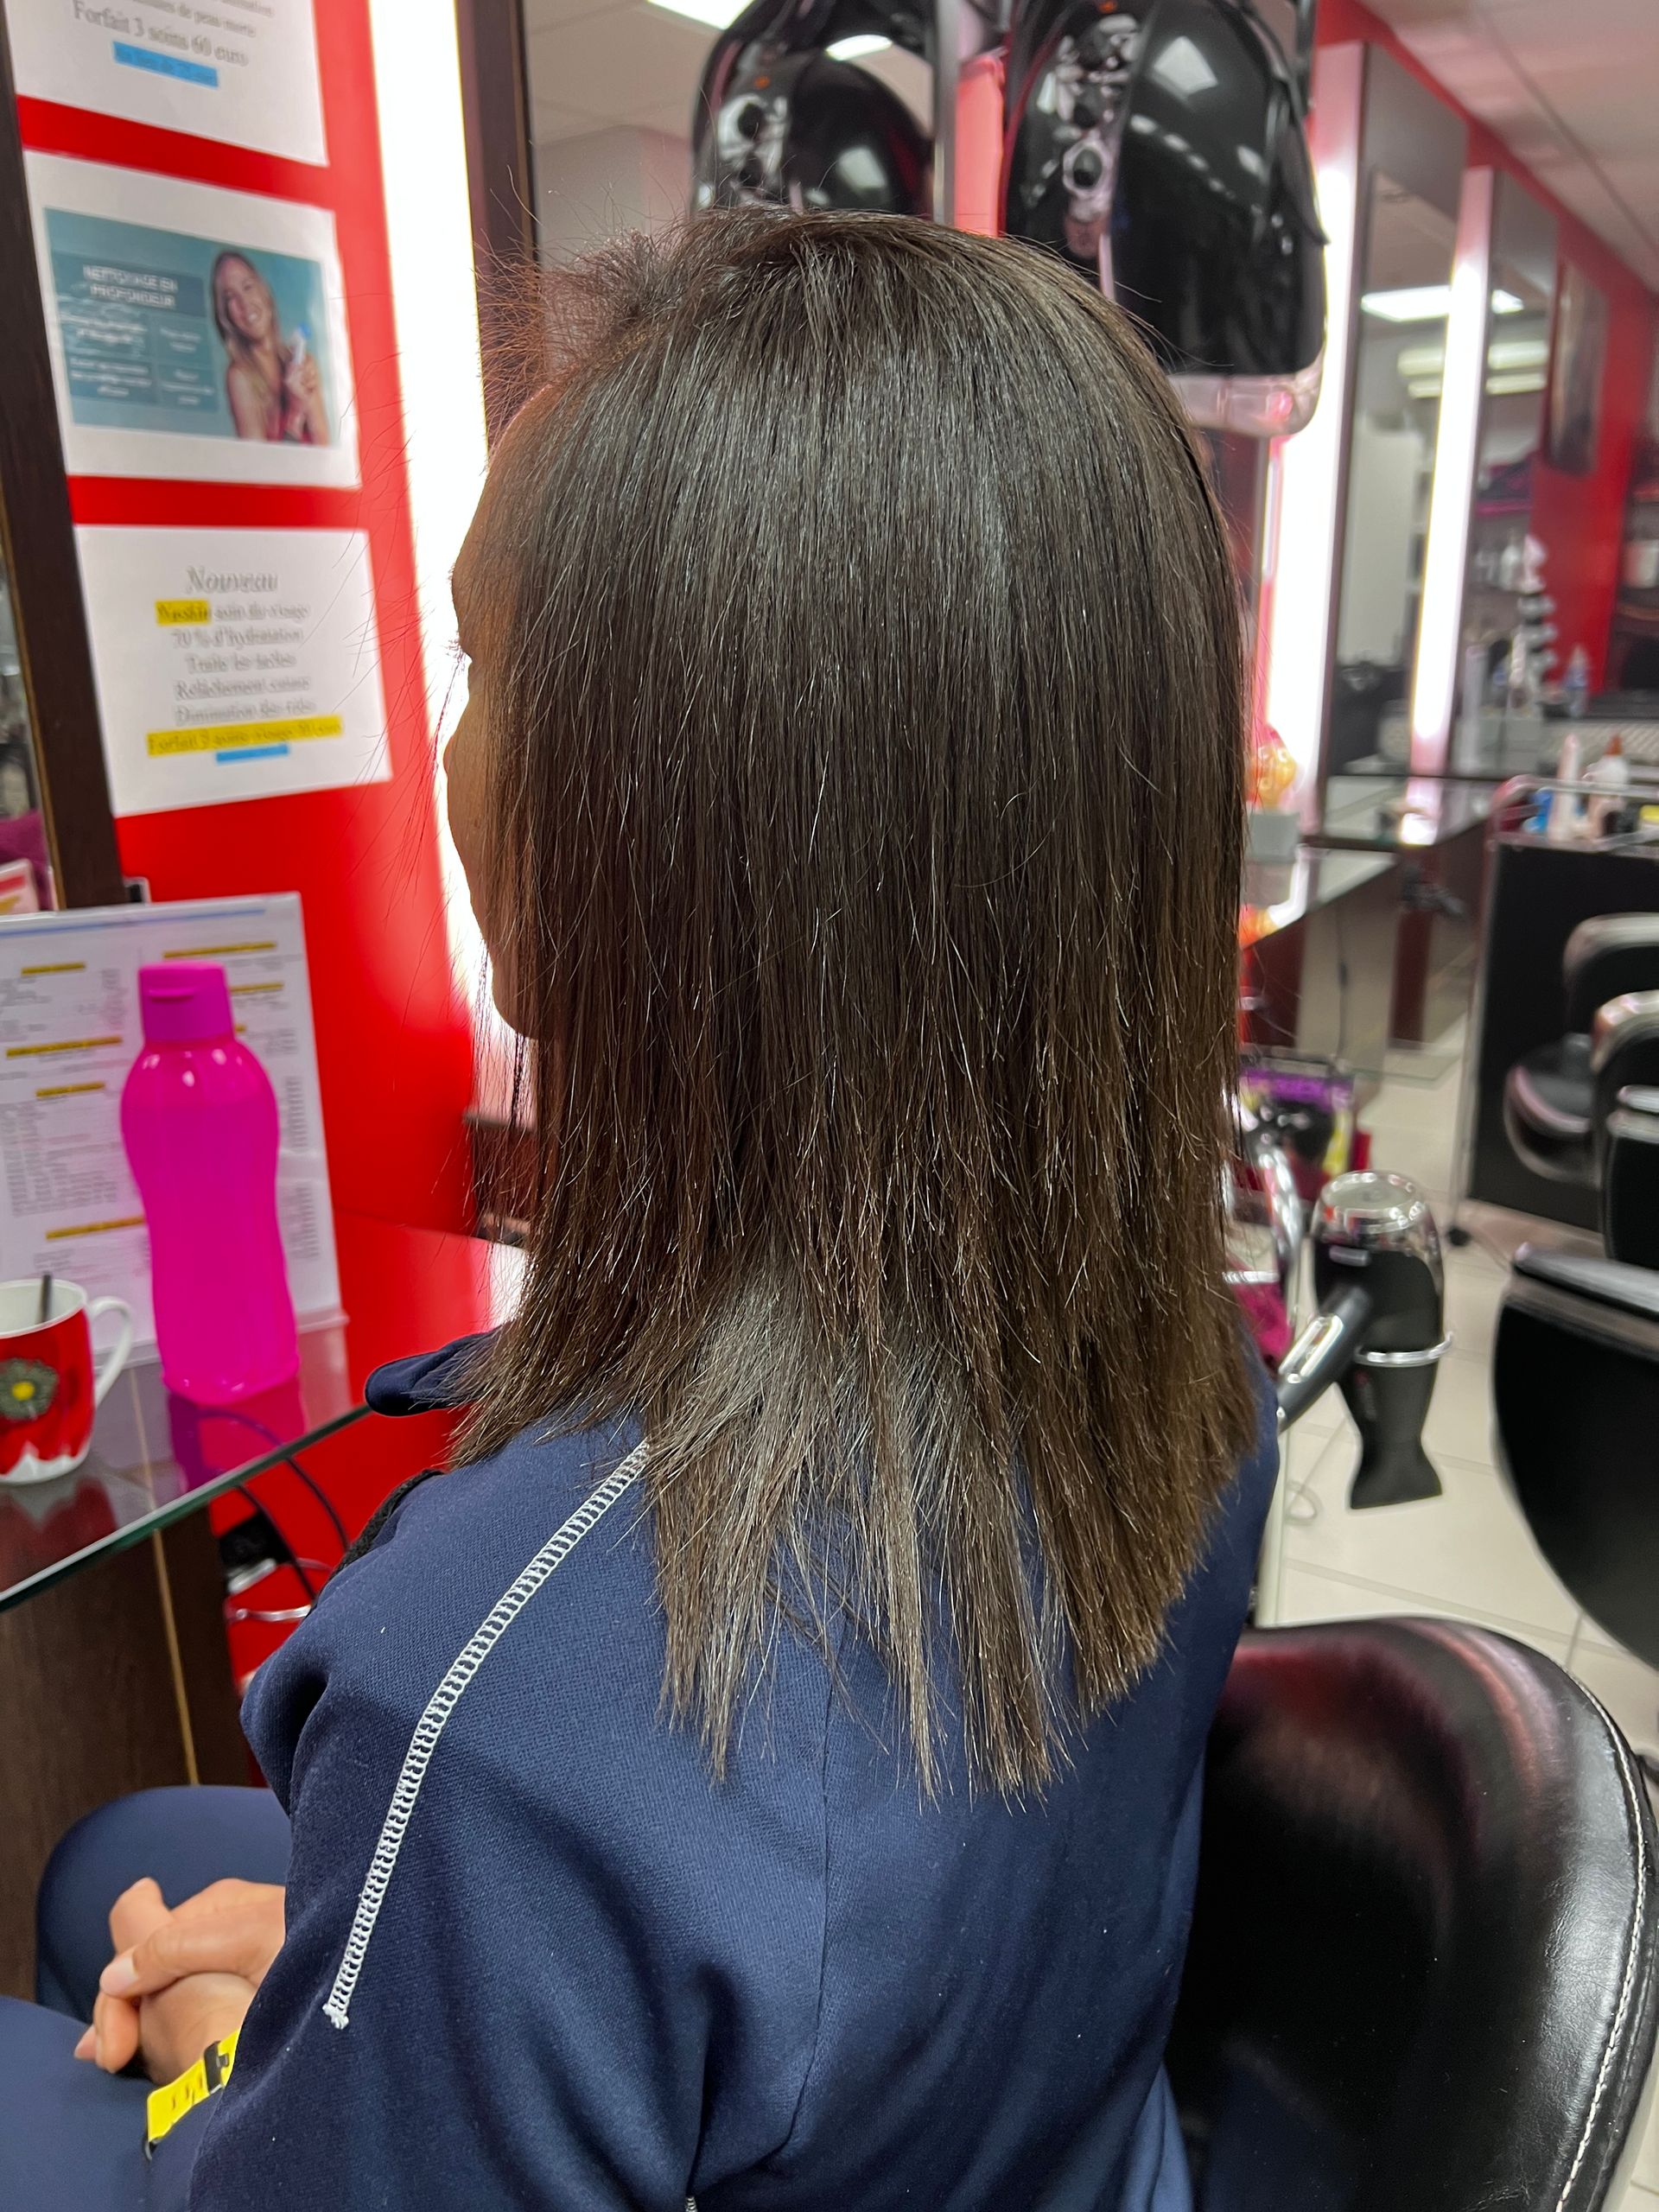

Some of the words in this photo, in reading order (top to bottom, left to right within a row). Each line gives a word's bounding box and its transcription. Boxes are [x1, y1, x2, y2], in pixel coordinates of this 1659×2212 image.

[72, 0, 130, 34] Forfait
[134, 17, 145, 37] 3
[185, 565, 278, 594] Nouveau
